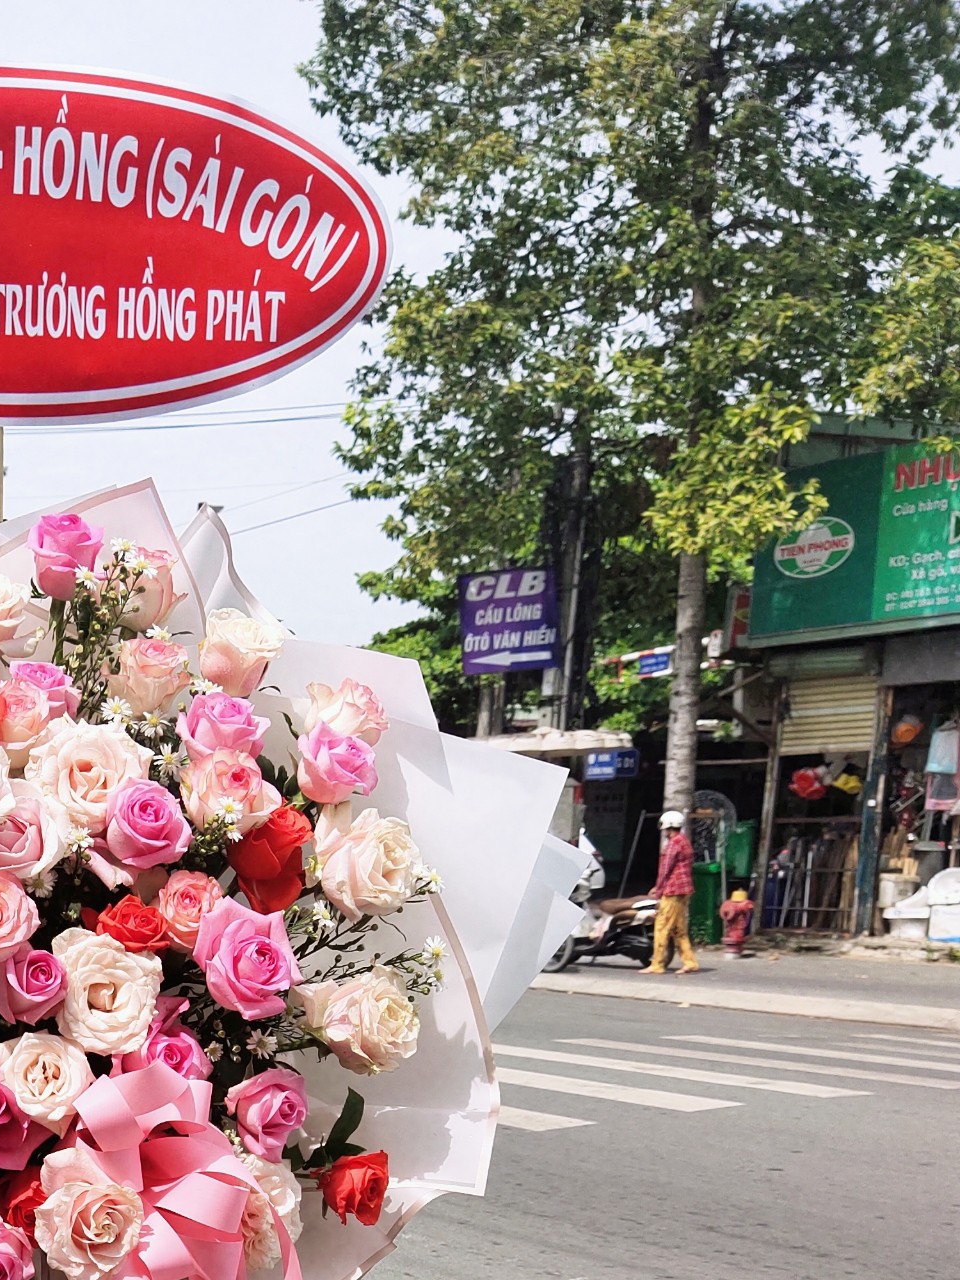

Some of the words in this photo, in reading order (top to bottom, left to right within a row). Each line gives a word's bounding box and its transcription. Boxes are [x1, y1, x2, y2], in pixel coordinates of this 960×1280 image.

[13, 93, 139, 208] HỒNG
[117, 256, 197, 342] HỒNG
[205, 269, 286, 343] PHÁT
[465, 571, 547, 601] CLB
[493, 629, 521, 649] VĂN
